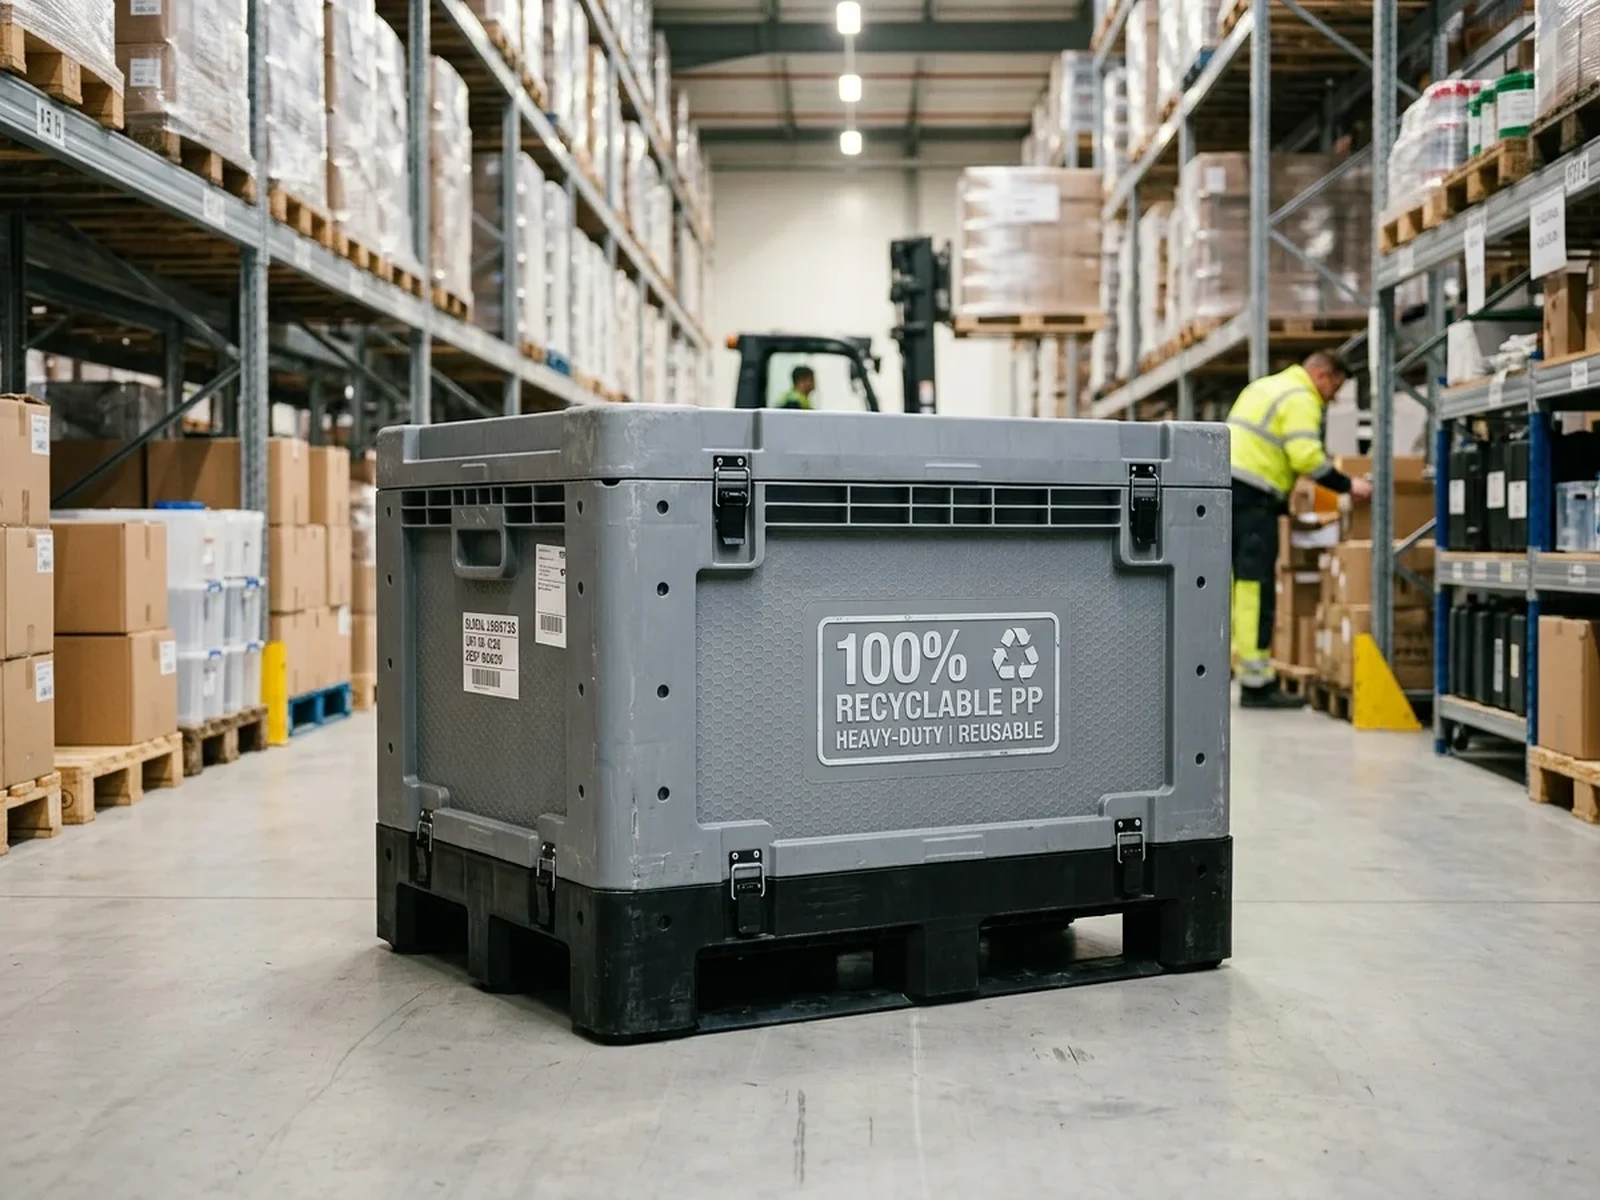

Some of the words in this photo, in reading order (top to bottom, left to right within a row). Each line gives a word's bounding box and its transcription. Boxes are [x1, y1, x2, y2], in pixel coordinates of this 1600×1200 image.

[836, 629, 968, 685] 100%
[836, 688, 1003, 723] RECYCLABLE
[1011, 686, 1044, 714] PP
[836, 725, 944, 750] HEAVY-DUTY
[958, 720, 1044, 743] REUSABLE
